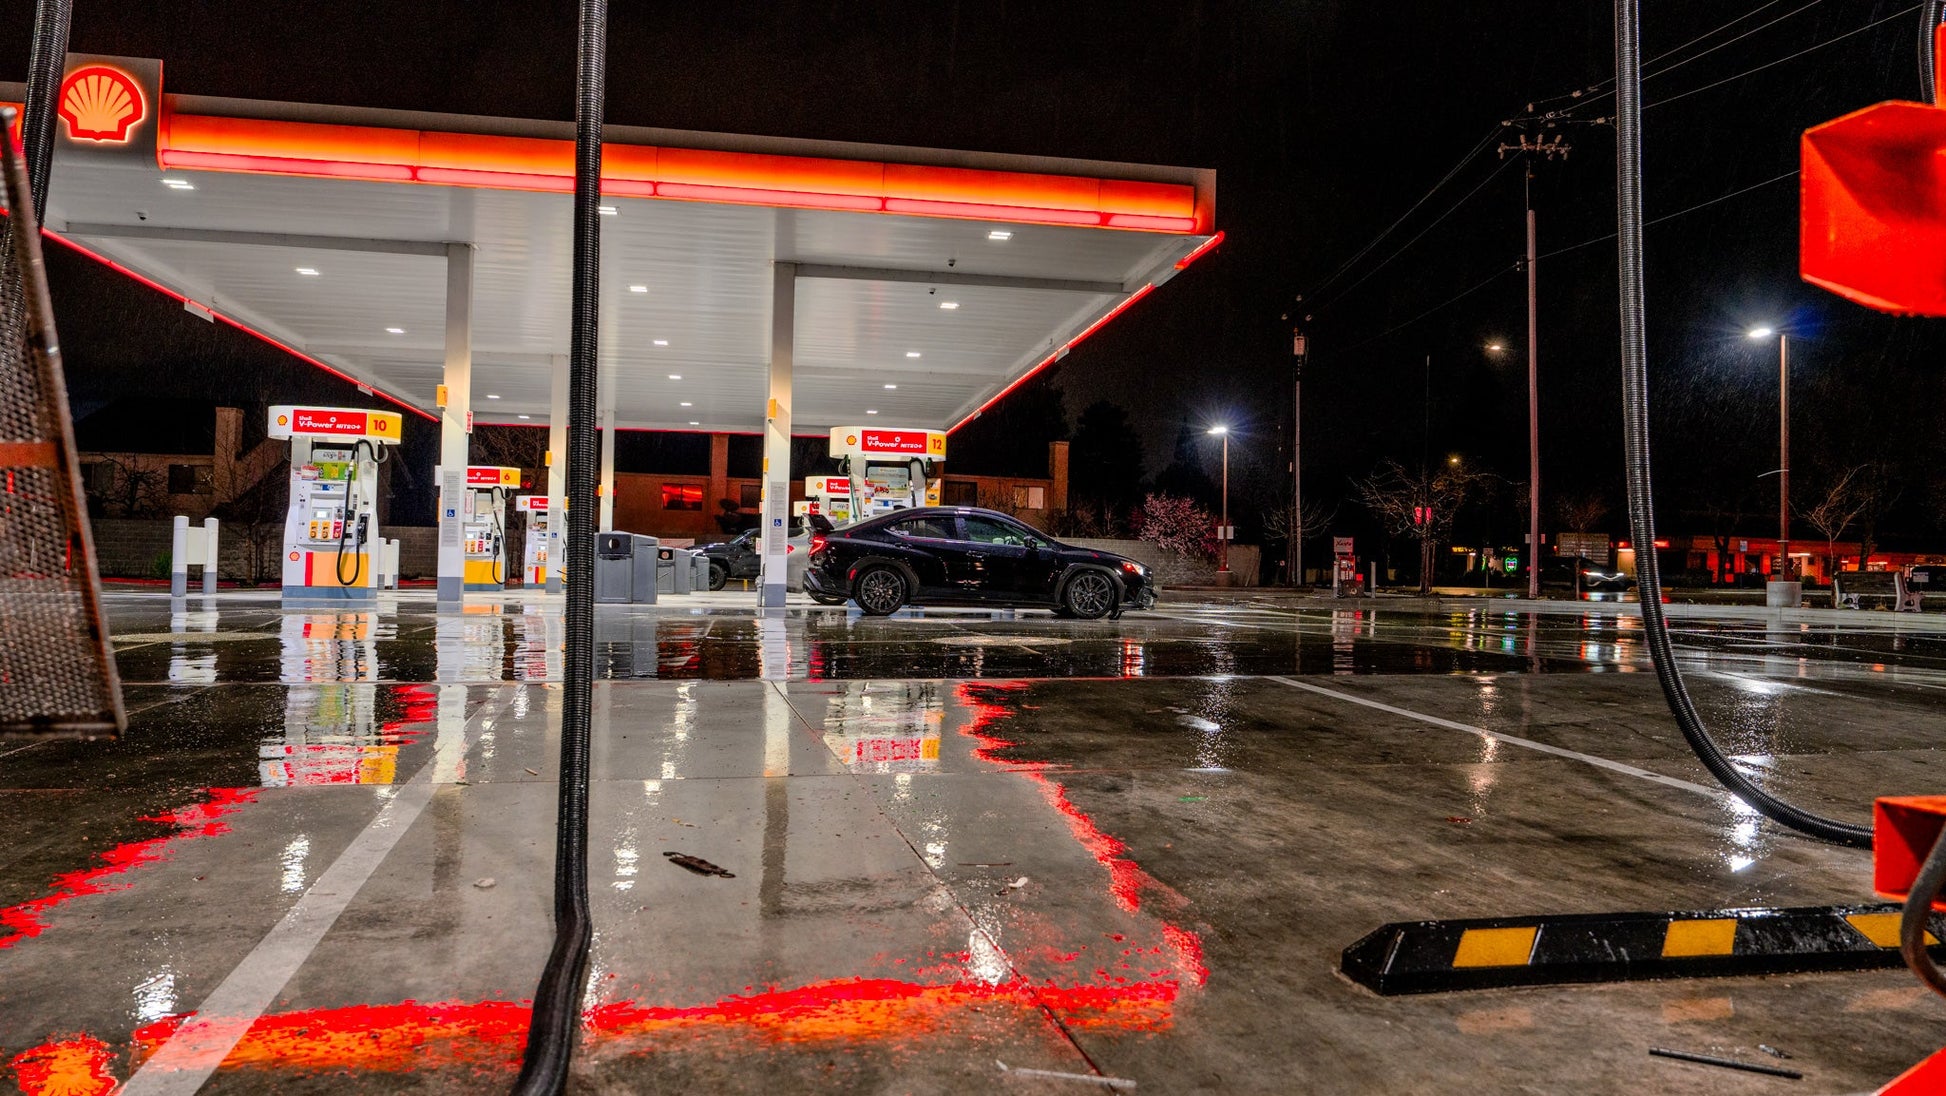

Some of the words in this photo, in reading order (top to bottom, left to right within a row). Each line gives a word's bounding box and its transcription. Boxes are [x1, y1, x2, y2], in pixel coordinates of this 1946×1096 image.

[373, 420, 387, 431] 10
[867, 440, 899, 448] V-Power
[932, 438, 942, 450] 12
[504, 473, 510, 481] 6
